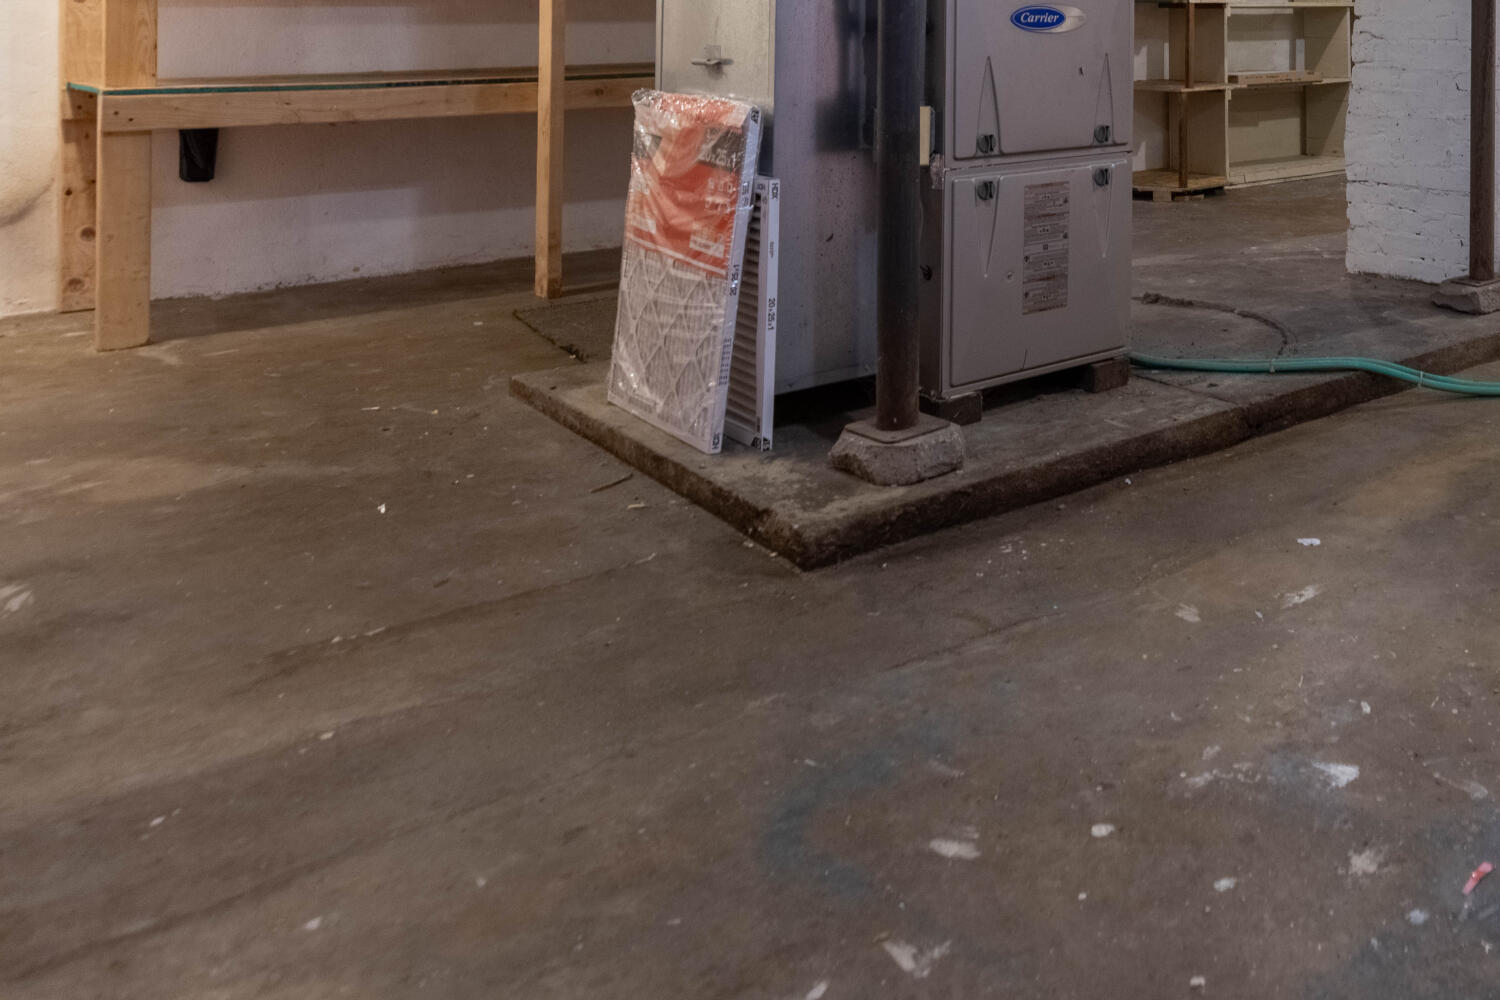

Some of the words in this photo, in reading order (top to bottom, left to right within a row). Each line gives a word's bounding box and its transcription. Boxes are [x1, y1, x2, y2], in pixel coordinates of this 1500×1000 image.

[1020, 12, 1060, 23] Carrier
[771, 182, 779, 200] HDX
[768, 298, 776, 331] 20x25x1
